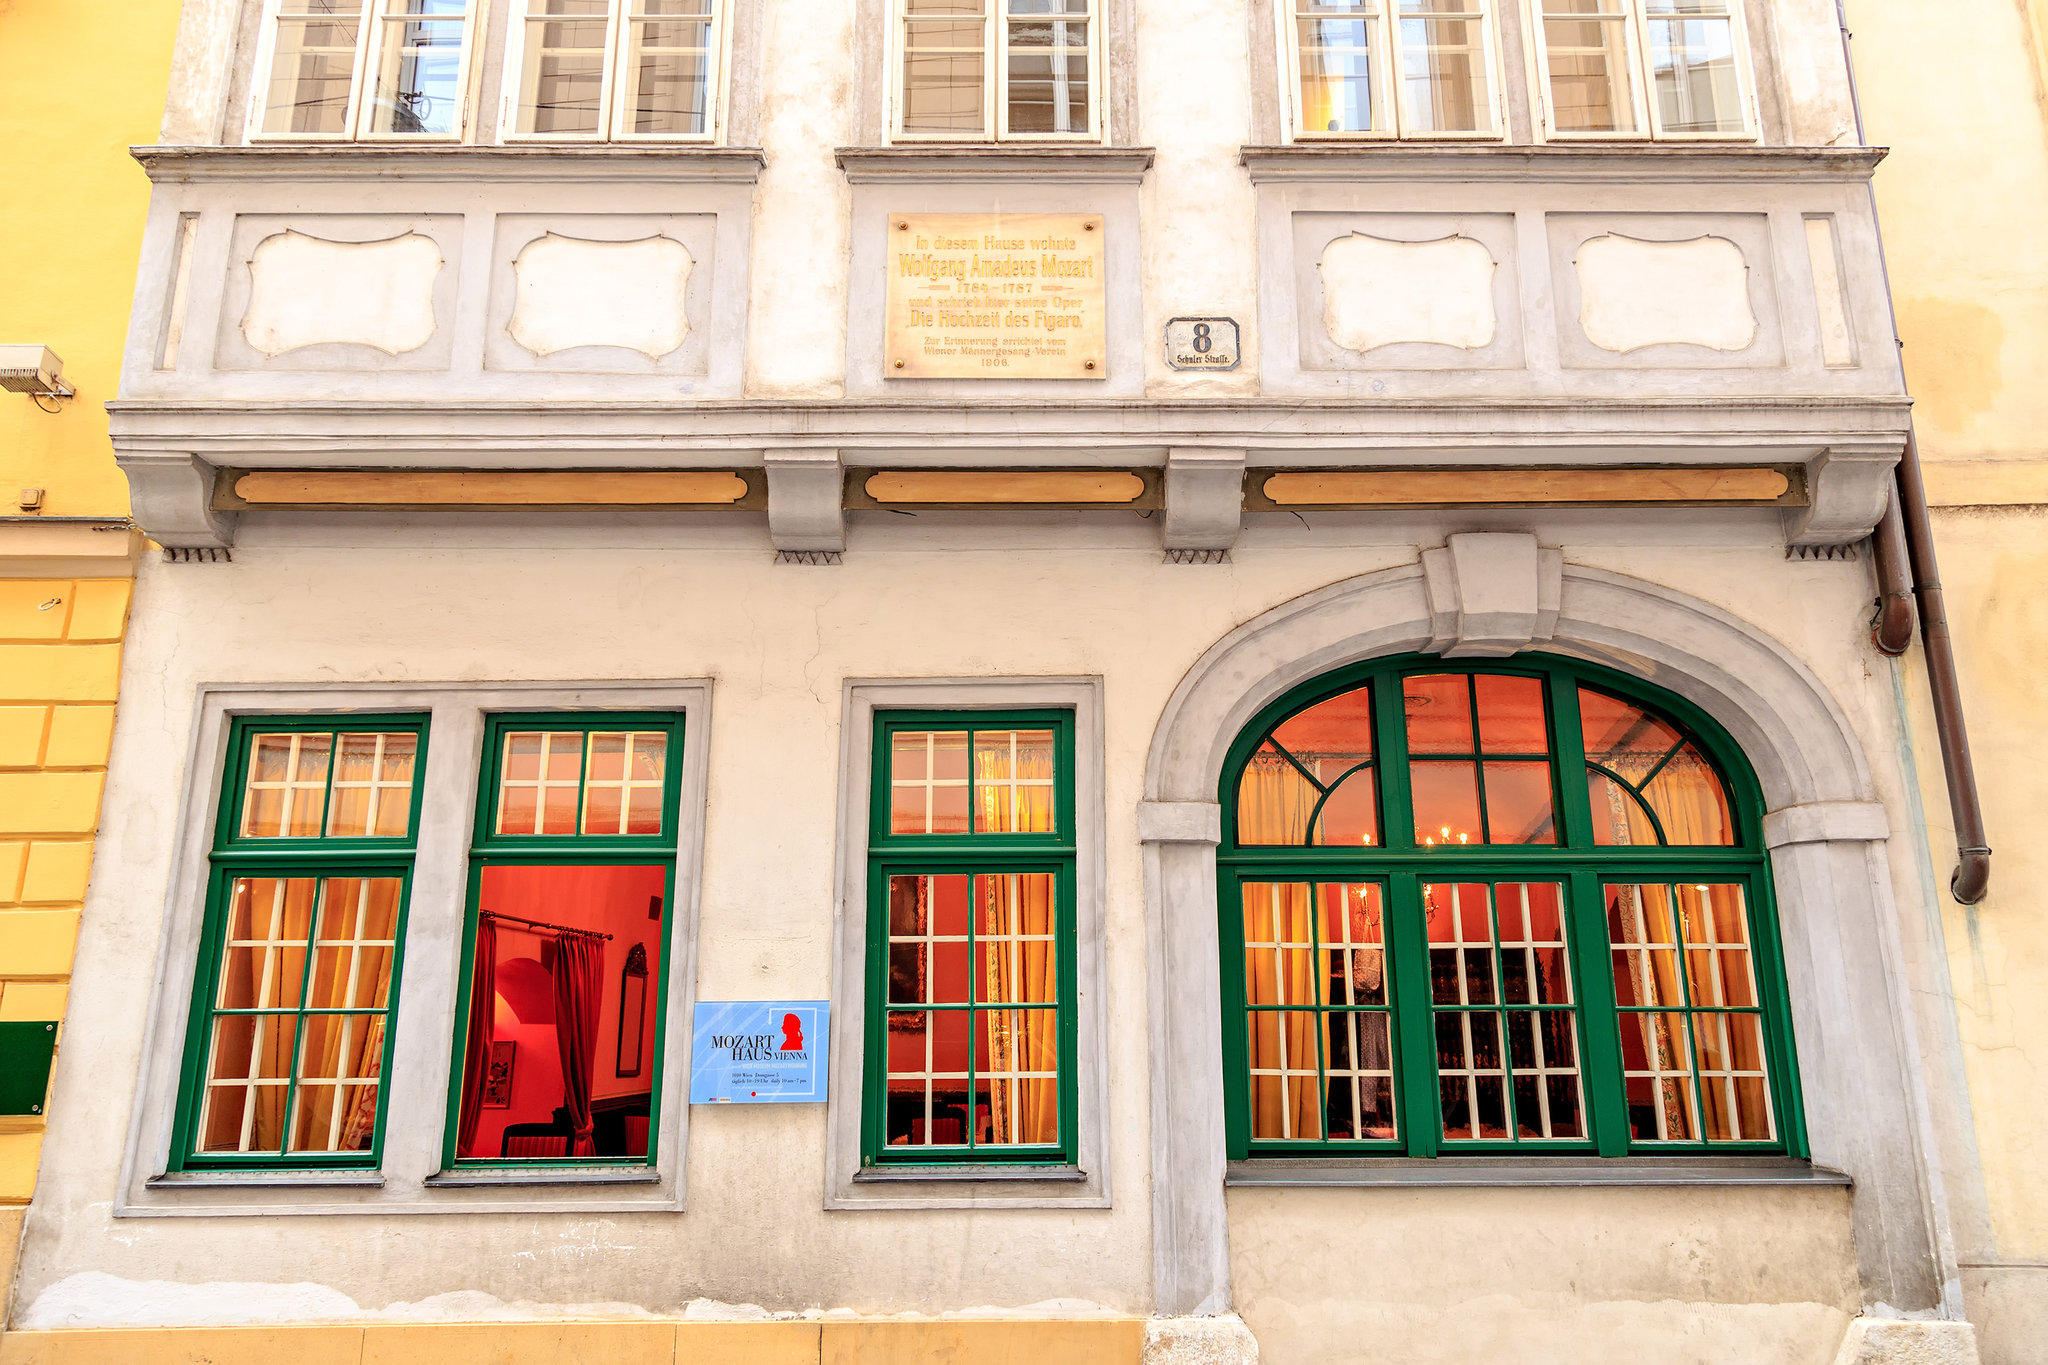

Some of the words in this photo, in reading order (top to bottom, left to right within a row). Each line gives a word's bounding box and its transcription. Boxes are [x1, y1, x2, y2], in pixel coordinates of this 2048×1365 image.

[916, 235, 928, 250] In
[933, 235, 978, 250] diesem
[984, 235, 1025, 250] Hause
[1030, 235, 1076, 250] wohnte
[899, 253, 966, 281] Wolfgang
[970, 253, 1037, 278] Amadeus
[1041, 253, 1094, 278] Mozart
[908, 296, 932, 307] und
[937, 296, 982, 307] schrieb
[985, 296, 1008, 307] hier
[1014, 297, 1047, 308] seine
[1053, 297, 1083, 311] Oper
[939, 310, 1000, 328] Hochzeit
[1004, 310, 1029, 328] des
[924, 337, 940, 346] Zur
[944, 337, 998, 348] Erinnerung
[1002, 337, 1043, 346] errichtet
[1046, 338, 1066, 346] vom
[1193, 323, 1212, 353] 8
[924, 347, 956, 356] Wiener
[1177, 354, 1202, 364] Schuler
[711, 1035, 775, 1048] MOZART
[732, 1047, 773, 1061] HAUS
[774, 1052, 808, 1060] VIENNA
